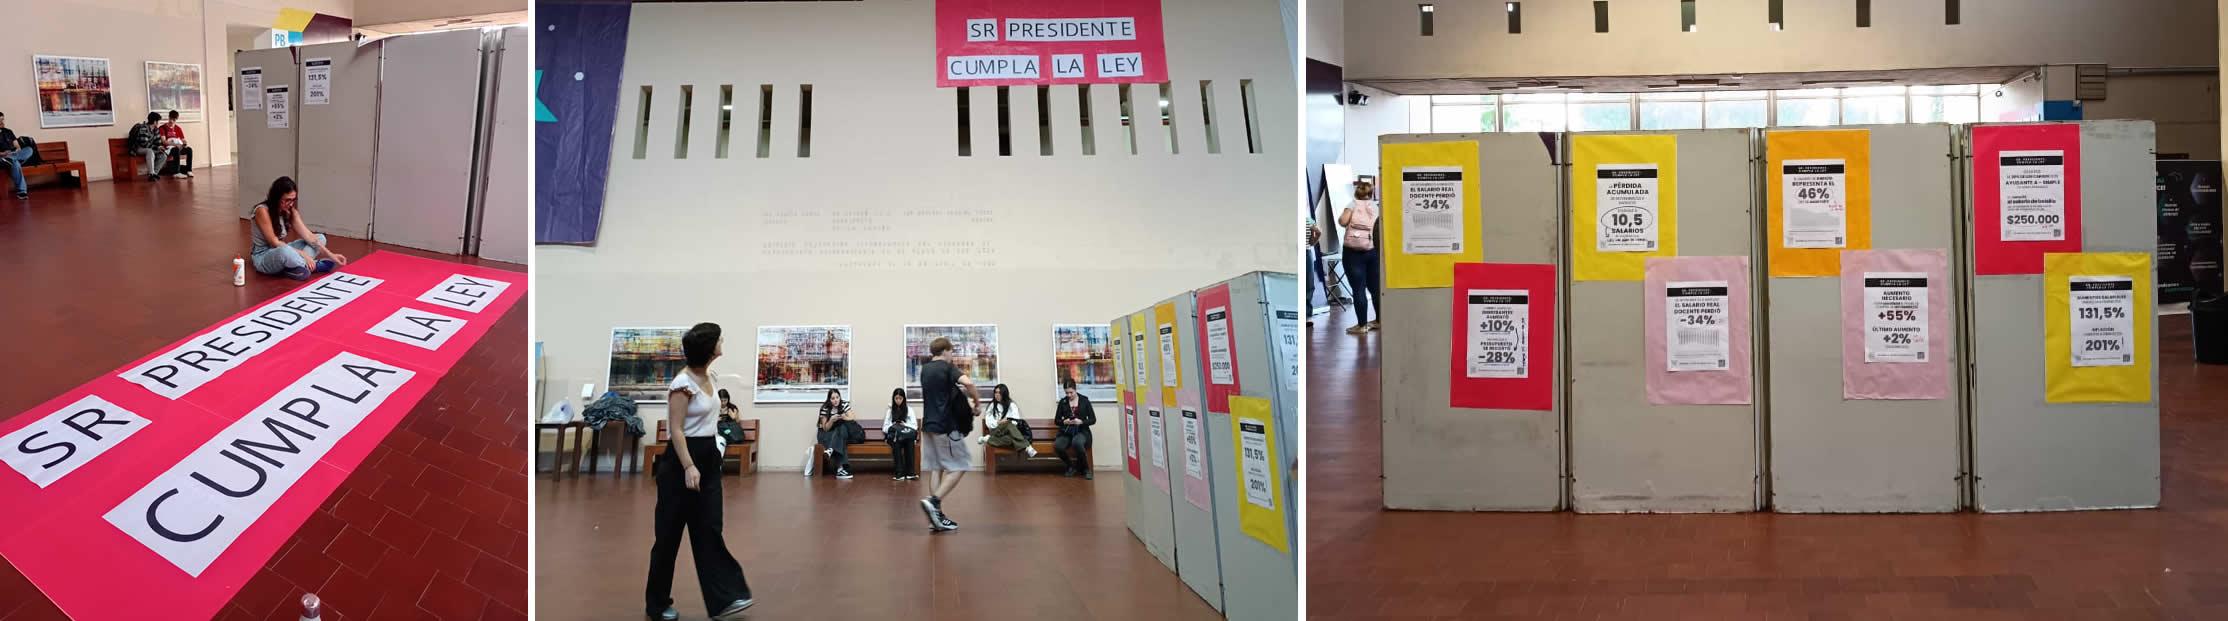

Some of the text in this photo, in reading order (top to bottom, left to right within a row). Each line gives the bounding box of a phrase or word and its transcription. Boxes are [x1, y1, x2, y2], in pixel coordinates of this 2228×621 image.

[970, 22, 1132, 38] SR PRESIDENTE
[274, 34, 286, 46] PB
[950, 57, 1138, 75] CUMPLA LA LEY
[1798, 188, 1830, 199] 46%
[1416, 200, 1450, 209] -34%
[1611, 213, 1643, 227] 10,5
[2007, 215, 2059, 224] $250.000
[1878, 310, 1916, 320] +55%
[2079, 307, 2125, 320] 131,5%
[1480, 320, 1514, 332] +10%
[1680, 315, 1715, 325] -34%
[1883, 333, 1911, 344] +2%
[2085, 340, 2120, 351] 201%
[1478, 352, 1515, 363] -28%
[18, 273, 372, 469] SR PRESIDENTE
[145, 276, 497, 543] CUMPLA LA LEY
[1245, 447, 1265, 461] 131,5%
[1250, 479, 1266, 492] 201%
